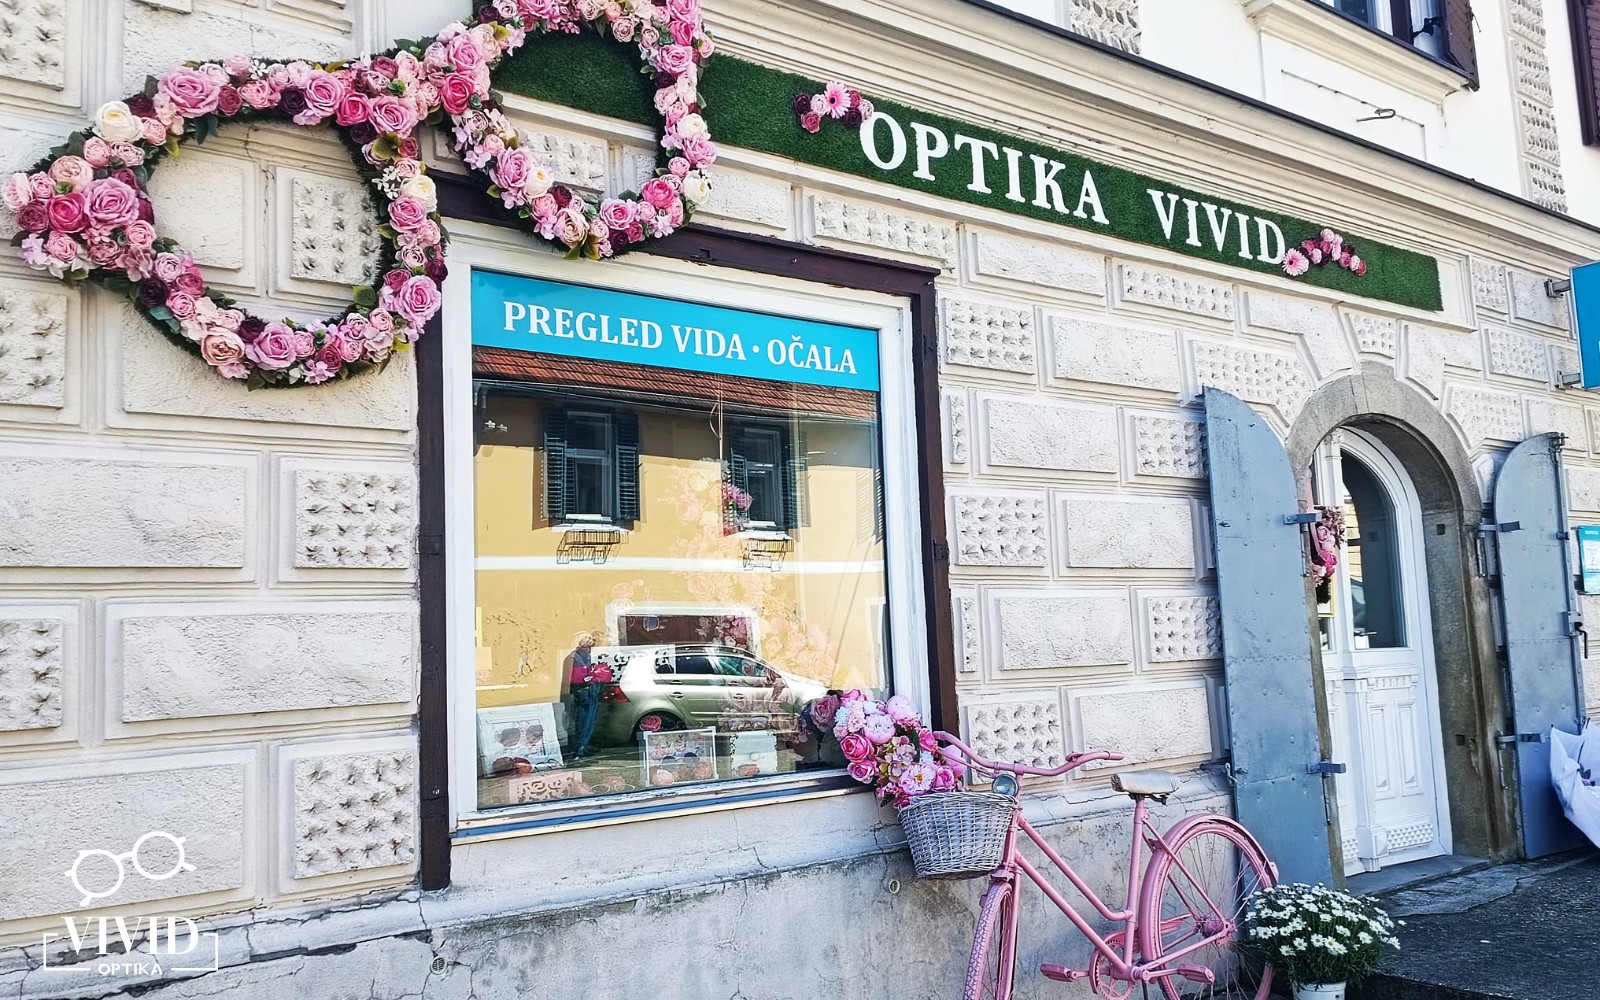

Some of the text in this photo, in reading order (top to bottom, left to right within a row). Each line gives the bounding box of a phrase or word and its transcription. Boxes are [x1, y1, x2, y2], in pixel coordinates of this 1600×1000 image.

[859, 112, 1286, 265] OPTIKA VIVID
[504, 301, 857, 374] PREGLED VIDA OČALA
